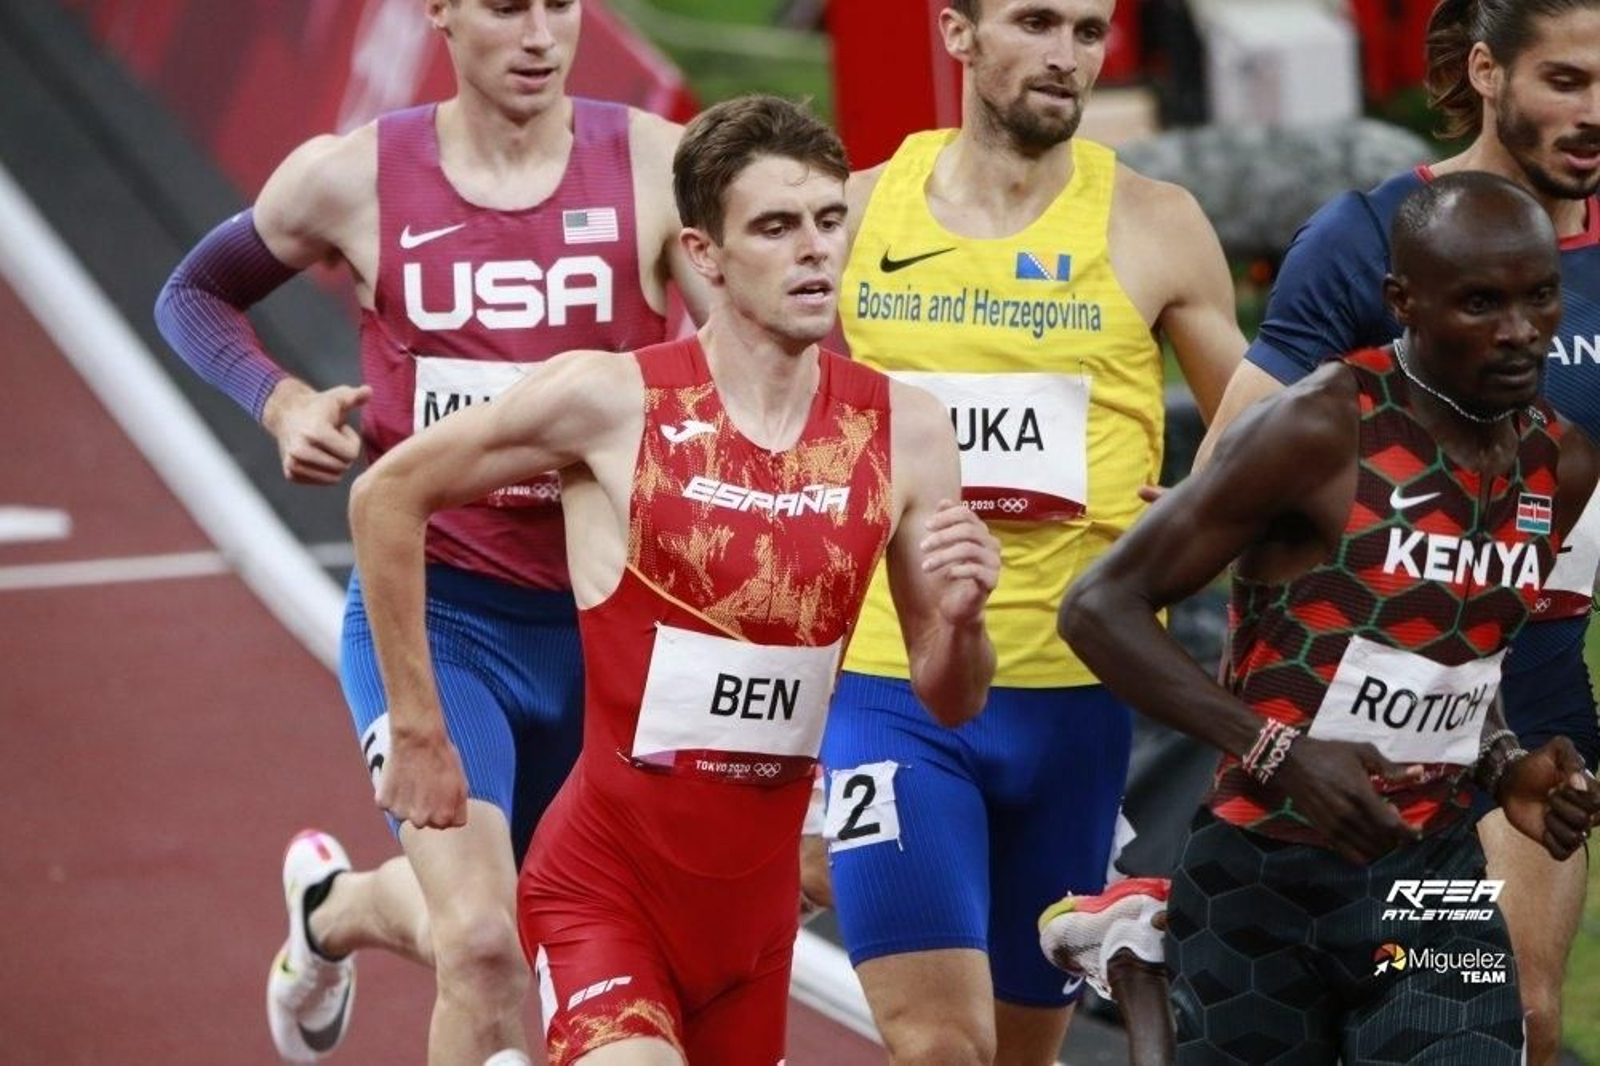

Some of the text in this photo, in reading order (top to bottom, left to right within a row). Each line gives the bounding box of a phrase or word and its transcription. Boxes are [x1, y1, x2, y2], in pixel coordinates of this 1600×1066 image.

[404, 255, 613, 331] USA
[857, 282, 1102, 339] Bosnia and Herzegovina
[682, 475, 852, 518] ESPAÑA
[970, 500, 995, 511] 2020
[1382, 527, 1541, 591] KENYA
[709, 672, 800, 721] BEN
[1350, 675, 1489, 734] ROTICH
[695, 759, 751, 774] TOKYO 2020
[837, 773, 881, 841] 2
